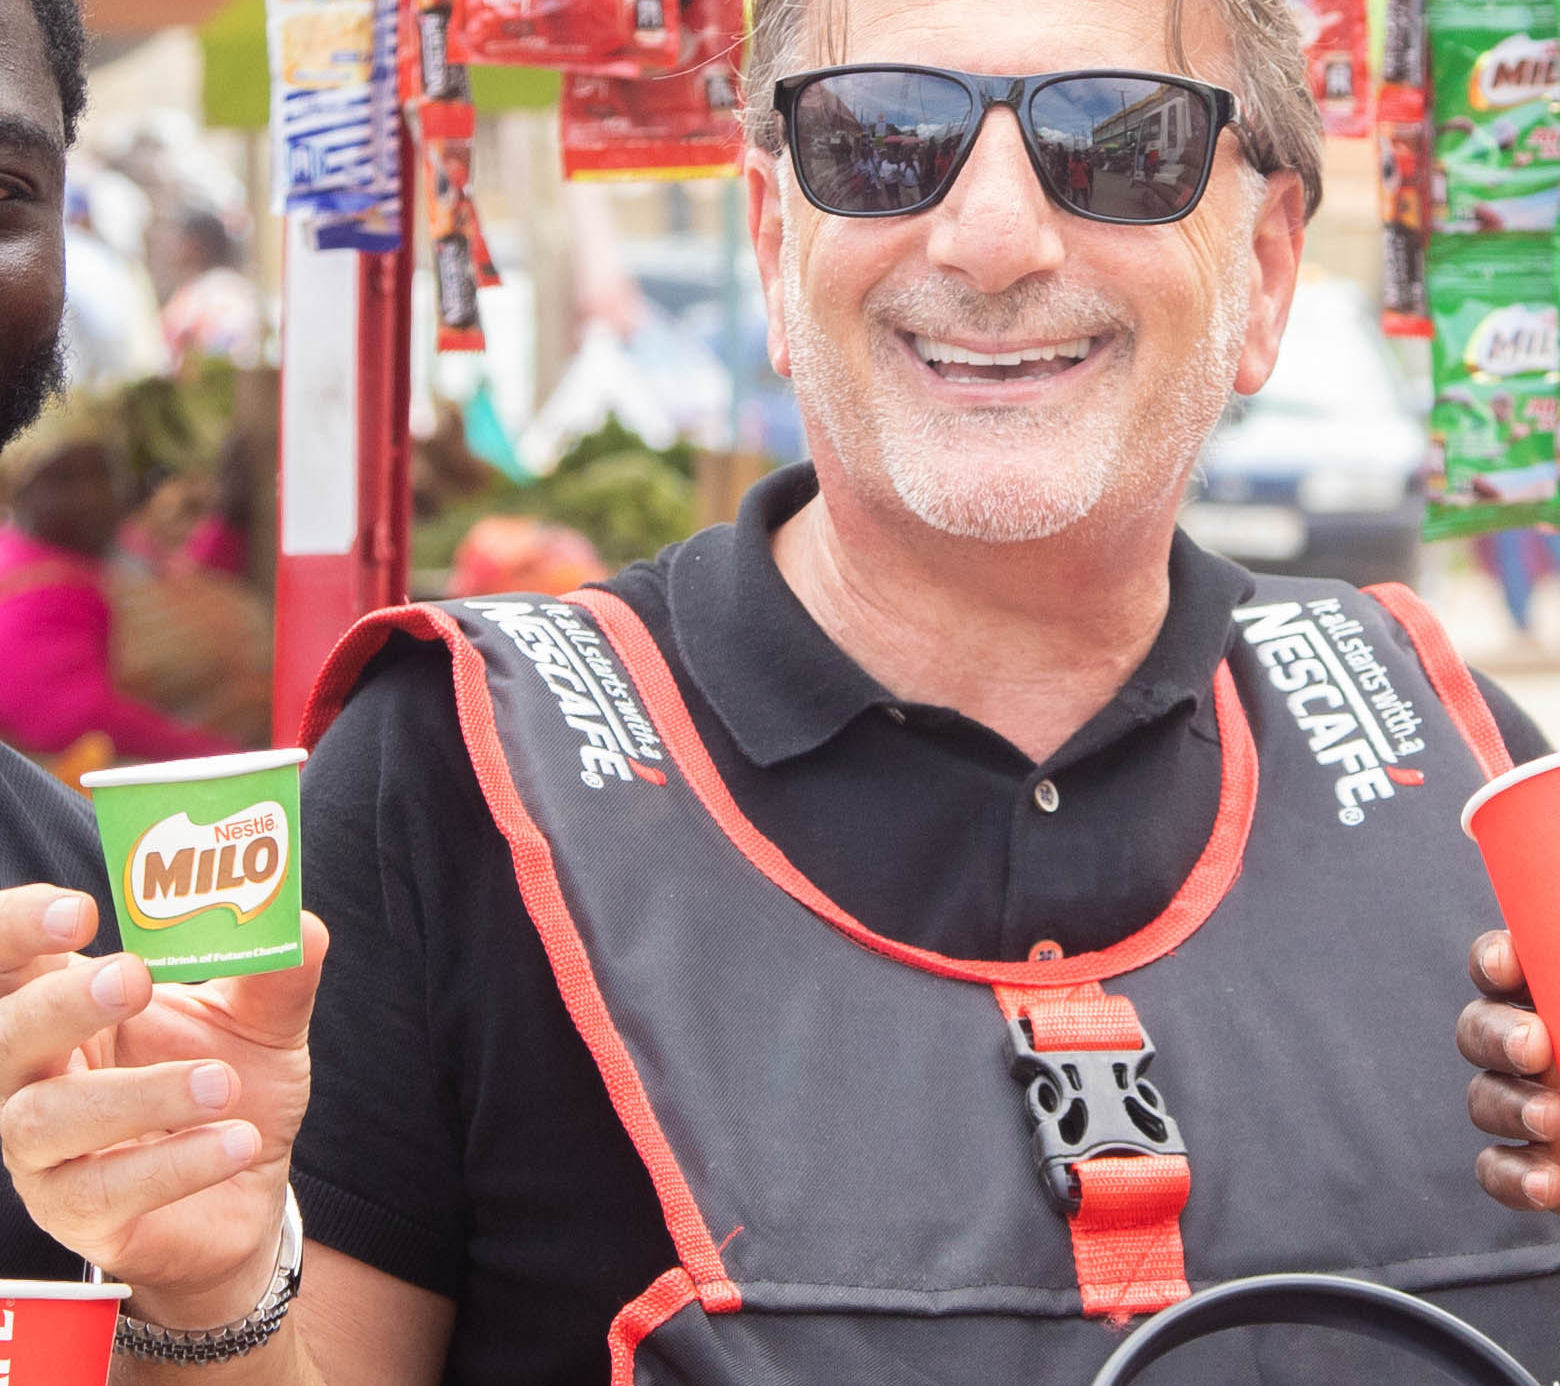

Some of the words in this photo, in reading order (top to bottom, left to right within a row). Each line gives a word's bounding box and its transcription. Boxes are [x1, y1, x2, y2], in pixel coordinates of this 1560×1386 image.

[1489, 329, 1557, 359] MIL
[1306, 598, 1341, 616] It
[1318, 613, 1364, 639] all
[553, 614, 600, 647] all
[580, 646, 628, 699] starts
[614, 694, 661, 745] with
[1337, 638, 1388, 692] starts
[1371, 687, 1423, 740] with
[1397, 737, 1426, 757] a
[214, 813, 276, 843] Nestlé
[142, 836, 279, 901] MILO
